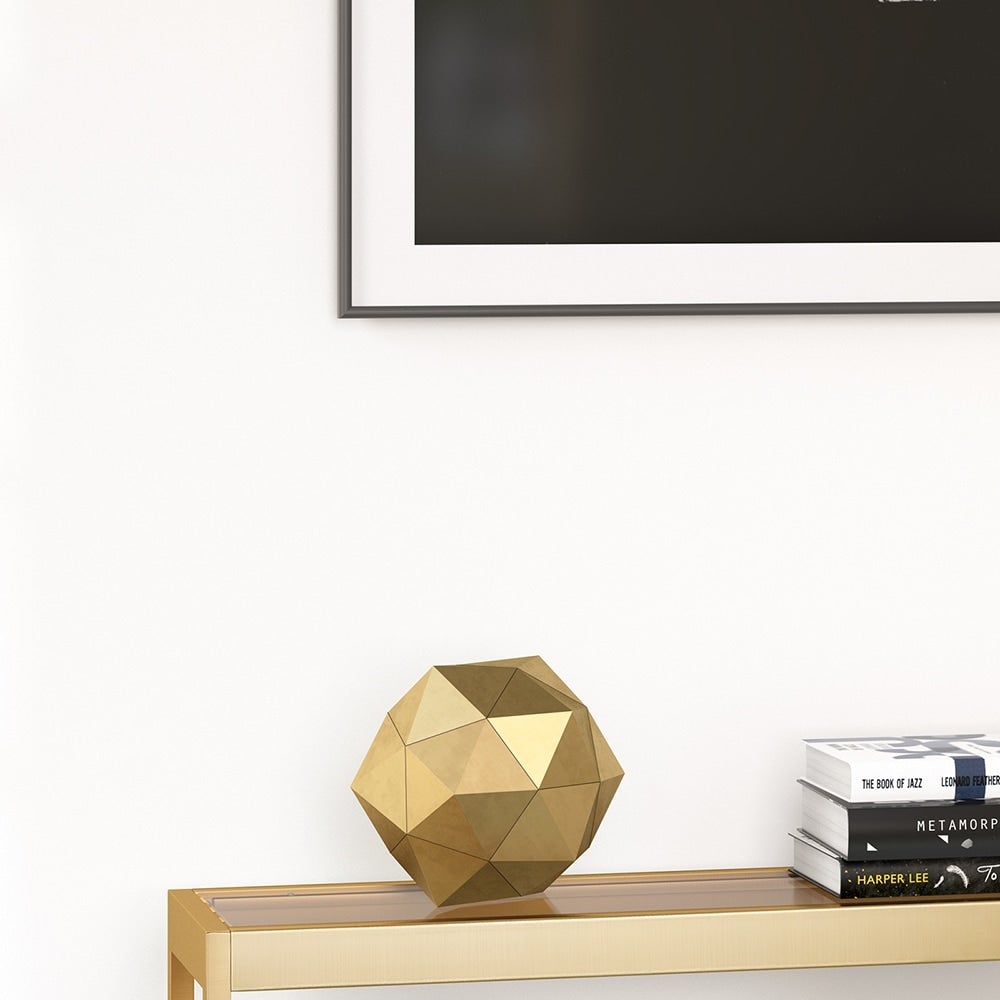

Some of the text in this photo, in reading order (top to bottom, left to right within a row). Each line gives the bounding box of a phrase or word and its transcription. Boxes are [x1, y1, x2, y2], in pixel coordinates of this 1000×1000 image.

[862, 778, 923, 789] THE BOOK OF JAZZ
[941, 775, 1000, 787] LEONARD FEATHER
[857, 872, 929, 885] HARPER LEE
